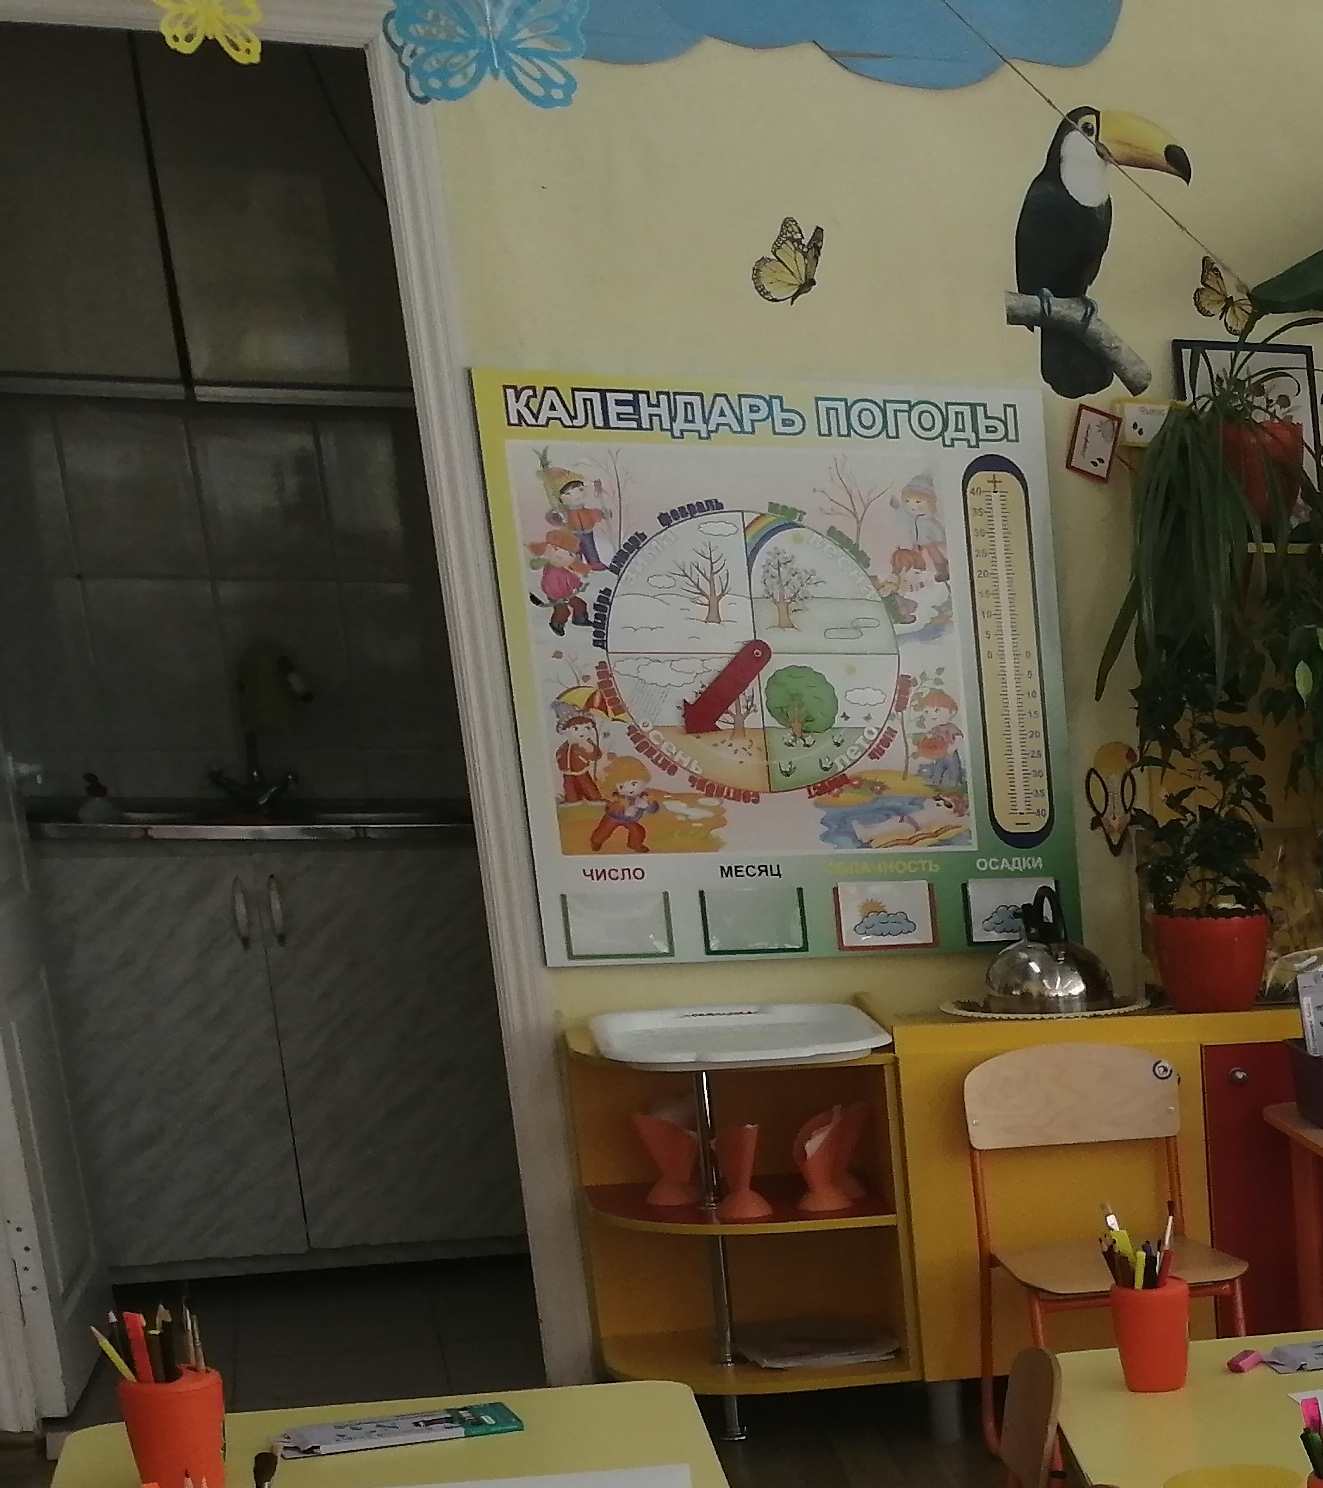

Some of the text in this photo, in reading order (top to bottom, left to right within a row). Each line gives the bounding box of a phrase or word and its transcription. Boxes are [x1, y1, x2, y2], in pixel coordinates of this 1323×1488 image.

[503, 386, 805, 440] КАЛЕНДАРЬ
[815, 396, 1020, 449] ПОГОДЫ
[639, 718, 703, 774] осень
[832, 726, 879, 771] лето
[582, 866, 646, 882] ЧИСЛО
[720, 863, 783, 881] МЕСЯЦ
[976, 855, 1044, 873] ОСАДКИ
